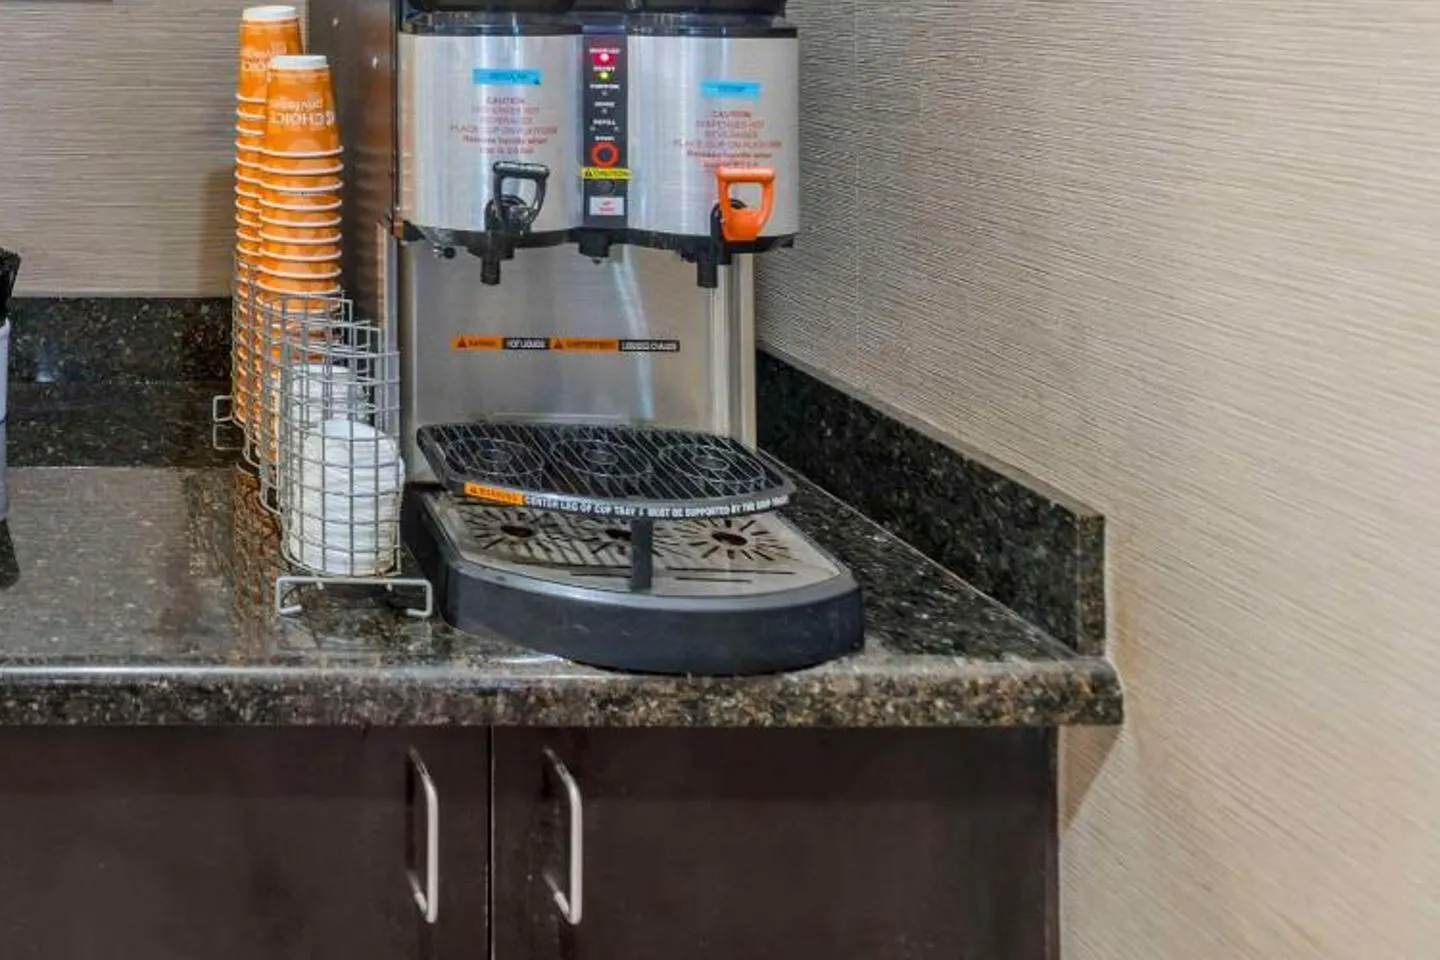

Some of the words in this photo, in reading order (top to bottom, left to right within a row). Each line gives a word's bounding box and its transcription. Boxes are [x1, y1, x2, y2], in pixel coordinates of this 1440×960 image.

[560, 498, 579, 511] LEG
[593, 502, 612, 514] CUP
[613, 504, 637, 516] TRAY
[685, 505, 730, 517] SUPPORTED
